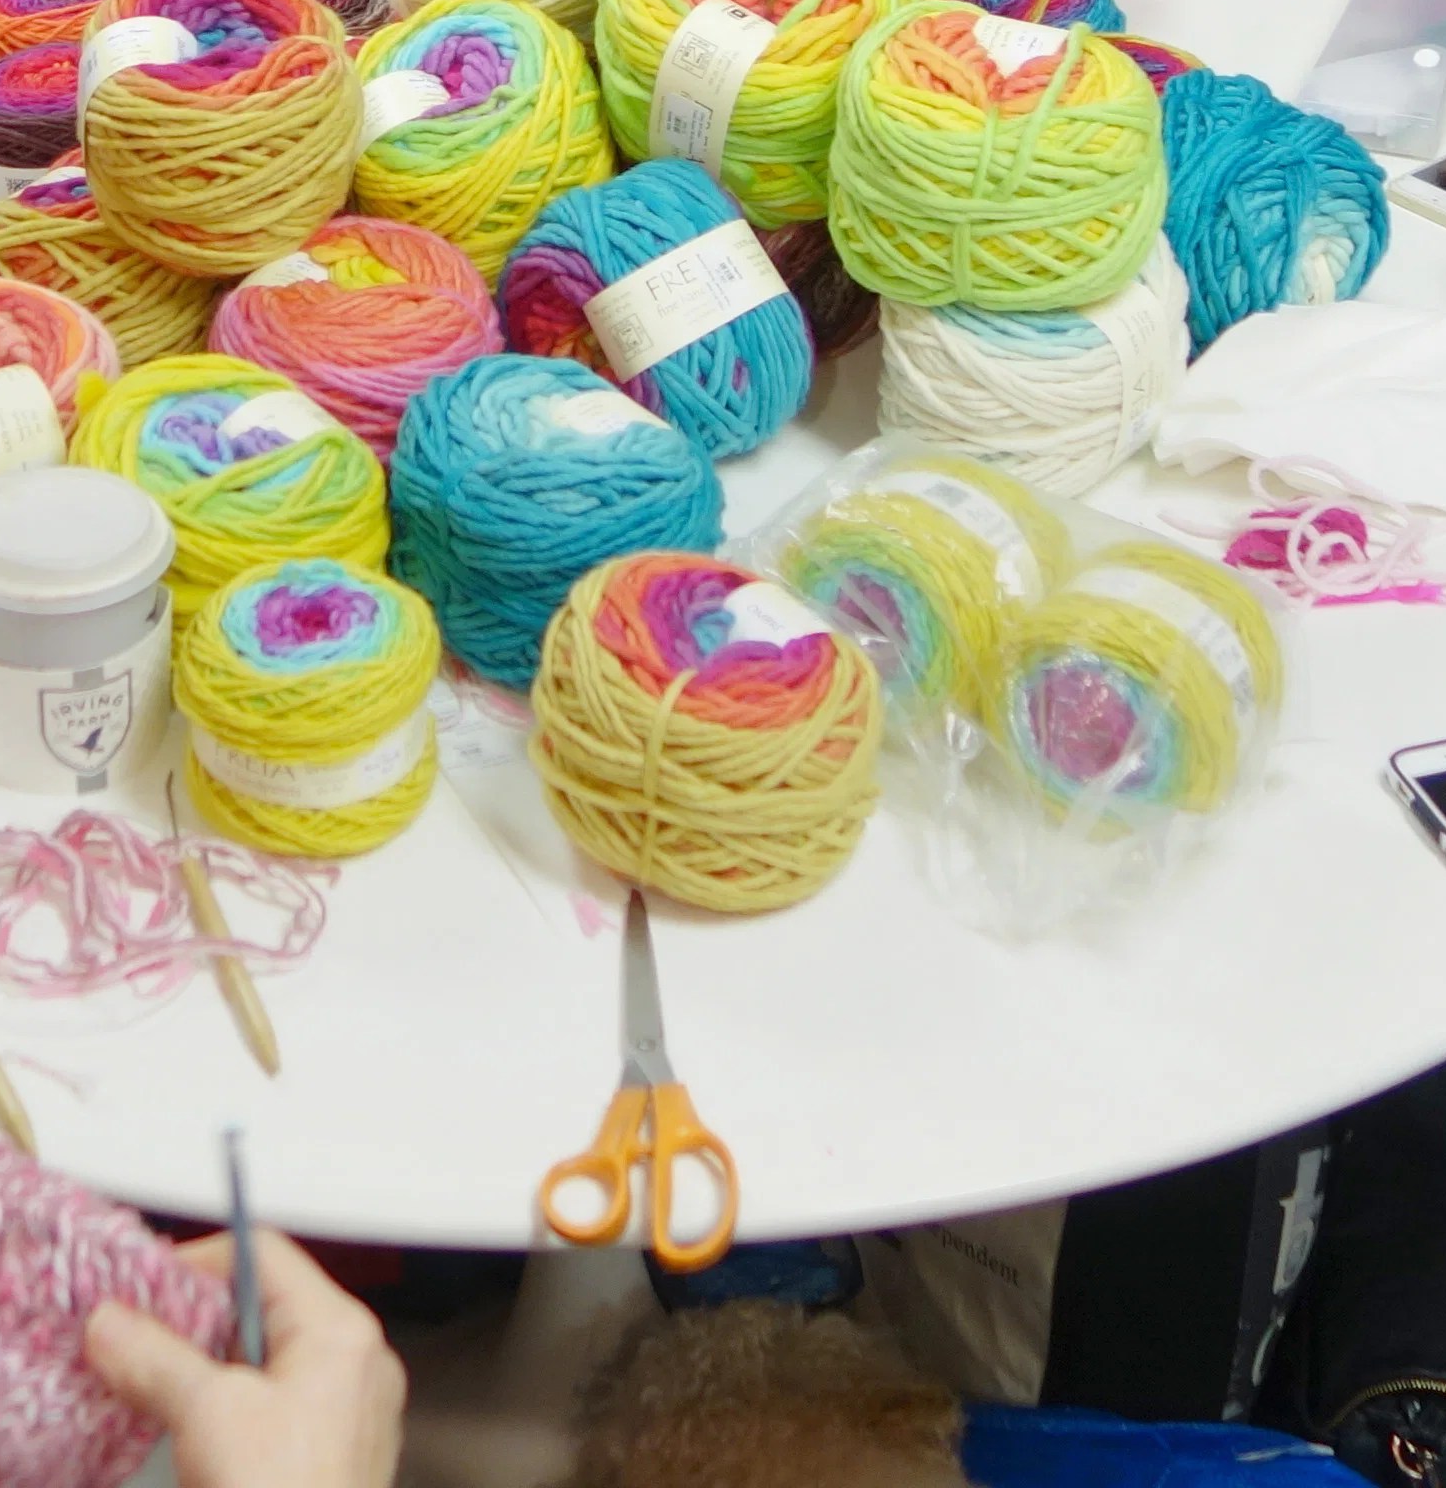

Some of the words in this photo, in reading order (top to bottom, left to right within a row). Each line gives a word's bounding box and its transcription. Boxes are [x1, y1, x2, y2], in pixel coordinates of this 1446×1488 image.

[645, 259, 699, 302] FRE
[50, 693, 124, 720] IRVING
[67, 711, 111, 729] FARM
[940, 1226, 1019, 1287] pendent
